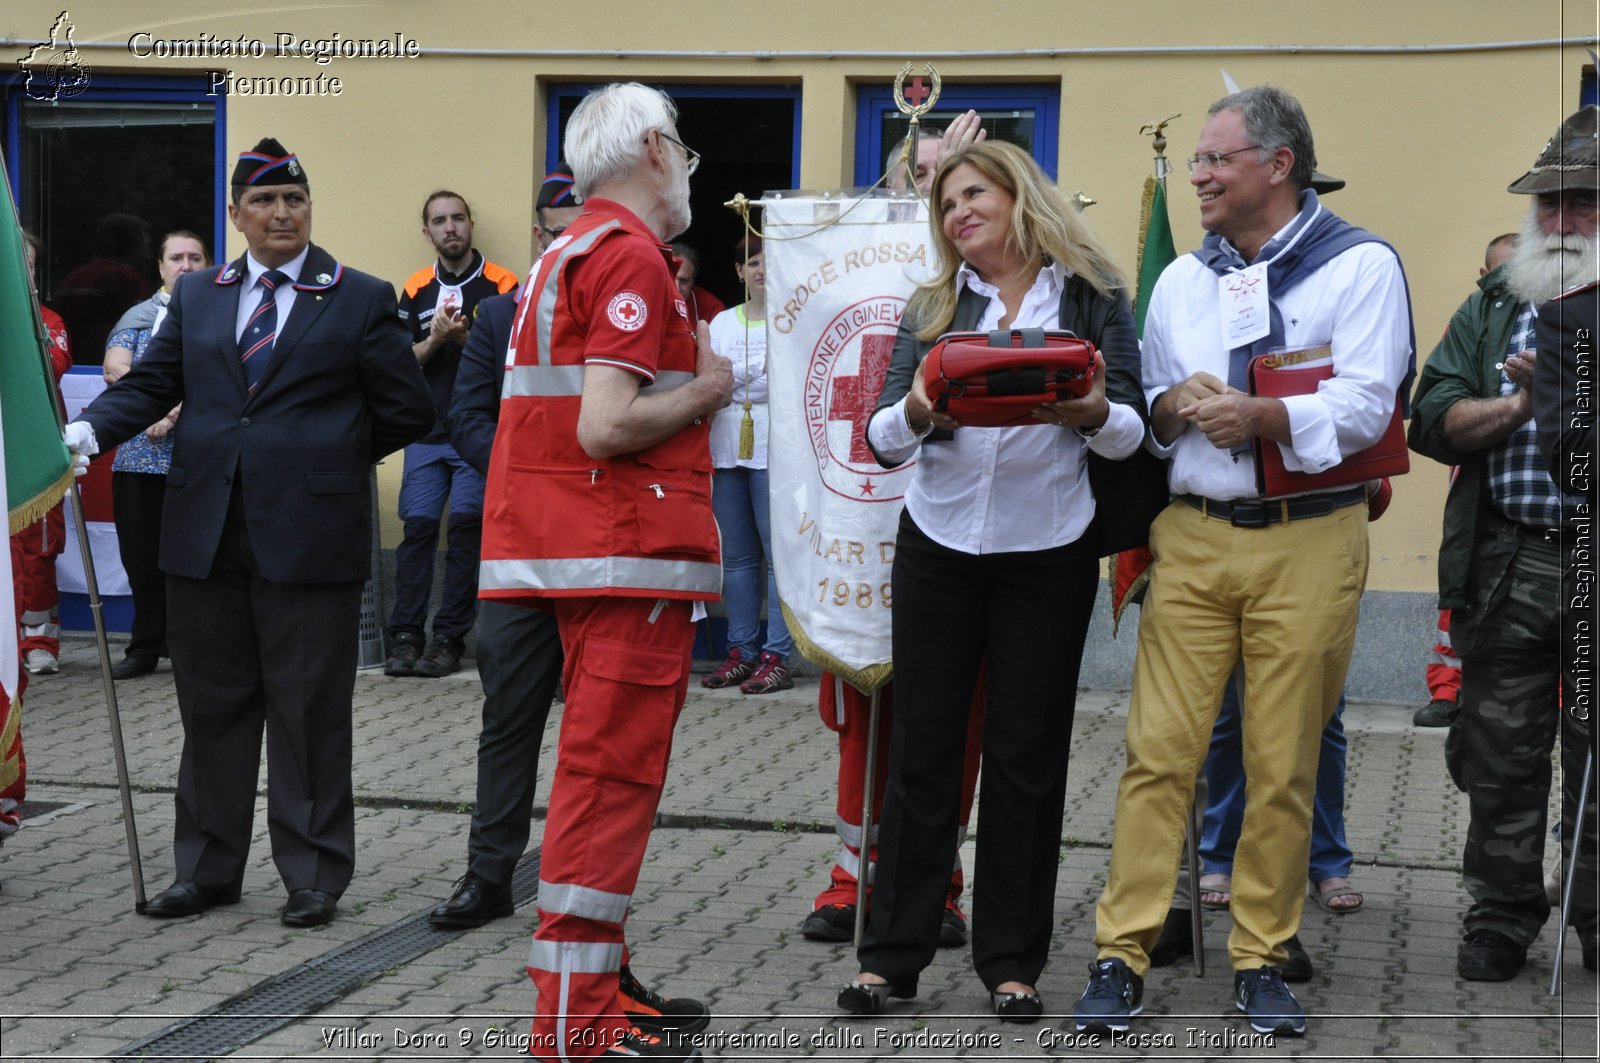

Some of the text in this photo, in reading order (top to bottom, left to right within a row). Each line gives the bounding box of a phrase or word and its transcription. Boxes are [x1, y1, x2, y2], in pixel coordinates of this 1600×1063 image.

[773, 260, 838, 335] CROCE
[844, 241, 926, 273] ROSSA
[808, 302, 905, 470] CONVENZIONE DI GINEV
[818, 577, 892, 609] 1989
